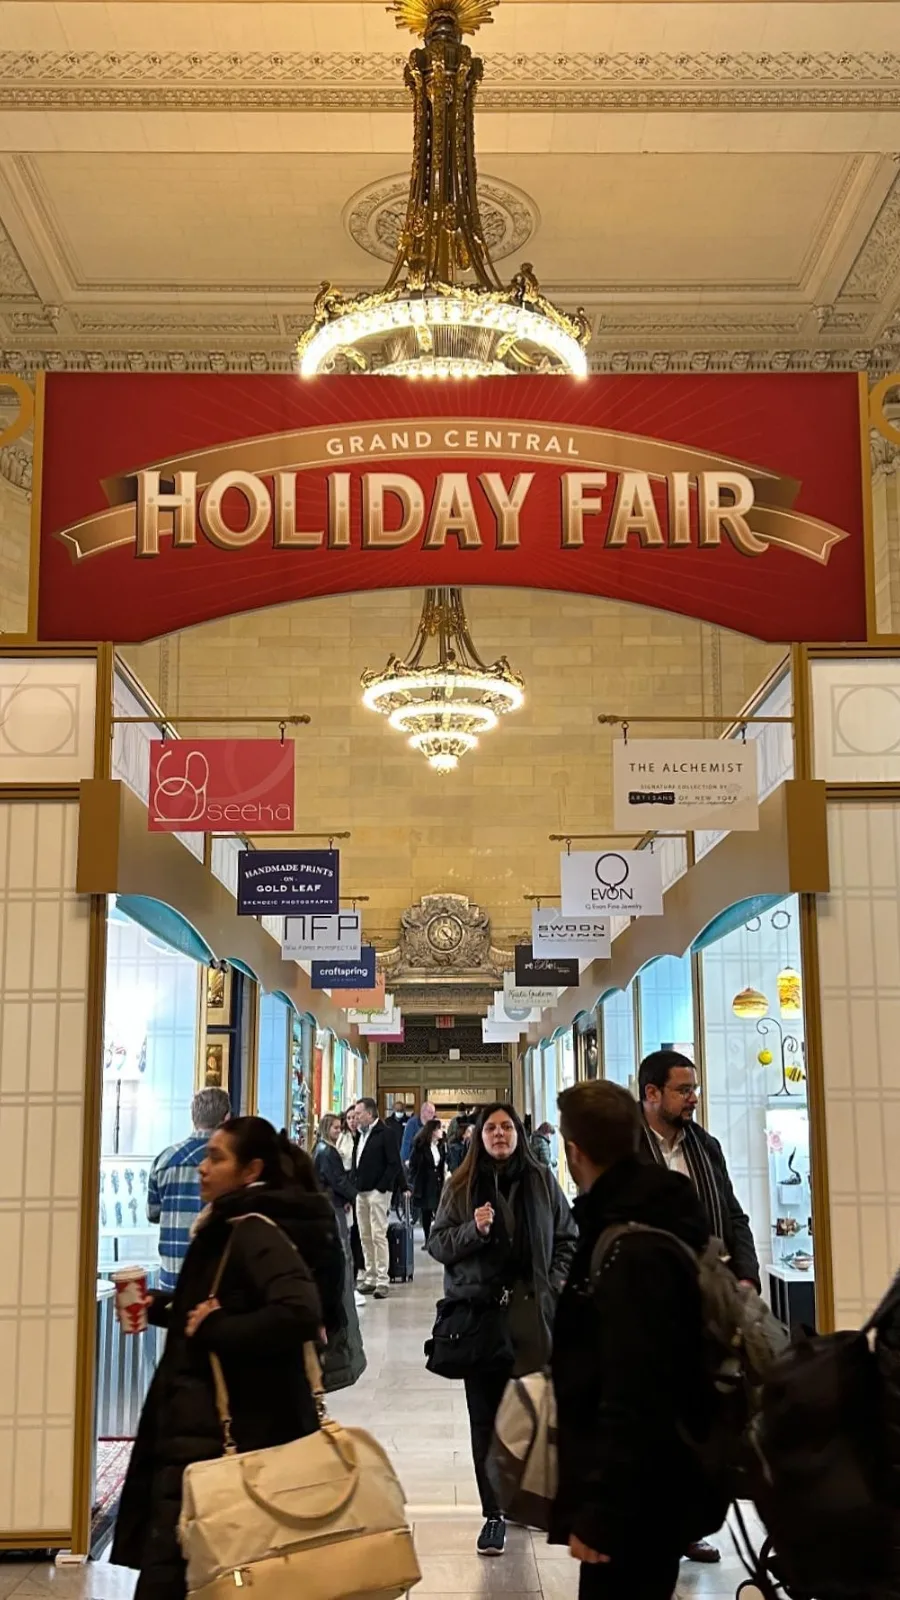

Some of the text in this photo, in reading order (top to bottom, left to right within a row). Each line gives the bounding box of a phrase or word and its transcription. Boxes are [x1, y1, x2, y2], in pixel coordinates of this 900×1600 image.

[326, 430, 580, 456] GRAND CENTRAL
[135, 469, 770, 558] HOLIDAY FAIR
[629, 763, 744, 773] THE ALCHEMIST
[206, 802, 291, 822] seeka
[245, 864, 334, 879] HANDMADE PRINTS
[292, 884, 321, 892] LEAF
[591, 888, 633, 900] EVON
[320, 966, 369, 977] craftspring
